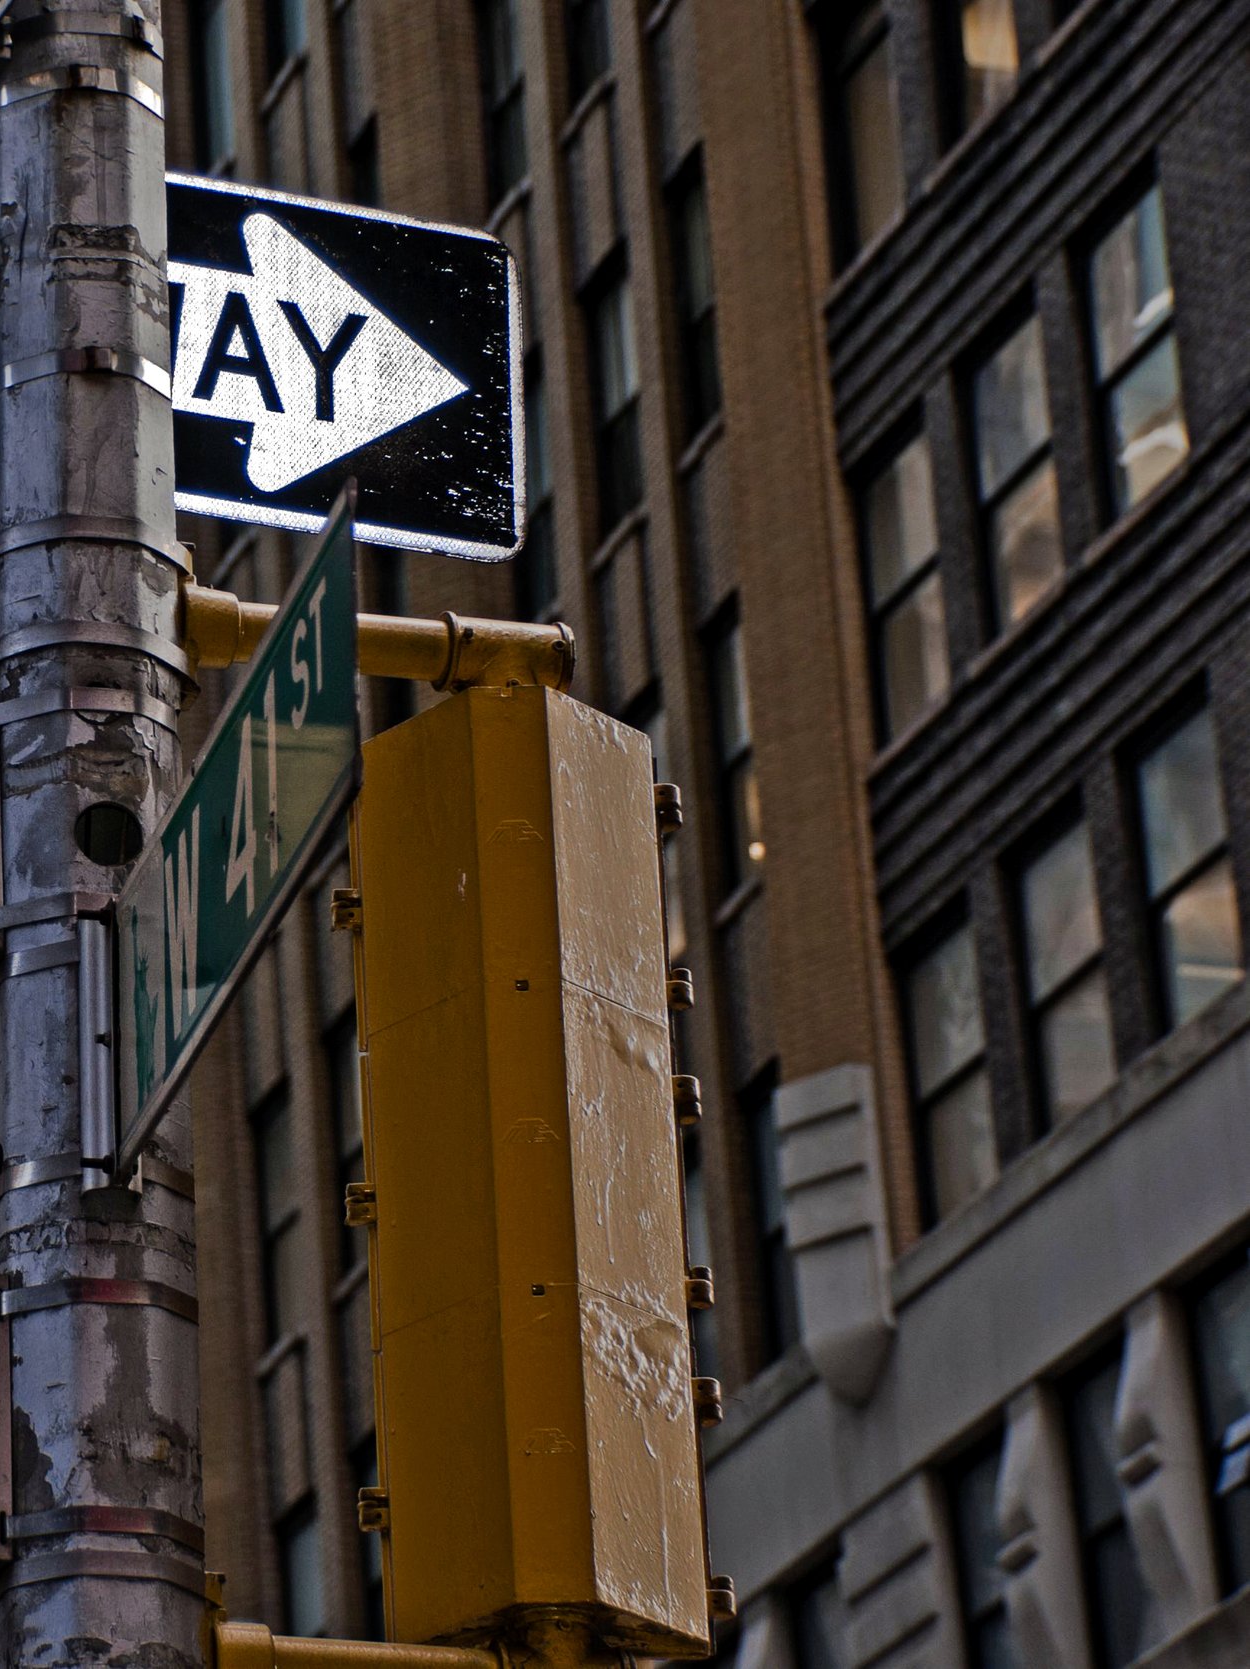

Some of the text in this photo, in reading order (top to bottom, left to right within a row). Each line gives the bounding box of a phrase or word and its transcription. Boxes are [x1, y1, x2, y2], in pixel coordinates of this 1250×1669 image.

[167, 282, 370, 423] AY
[164, 576, 326, 1041] W 41 ST
